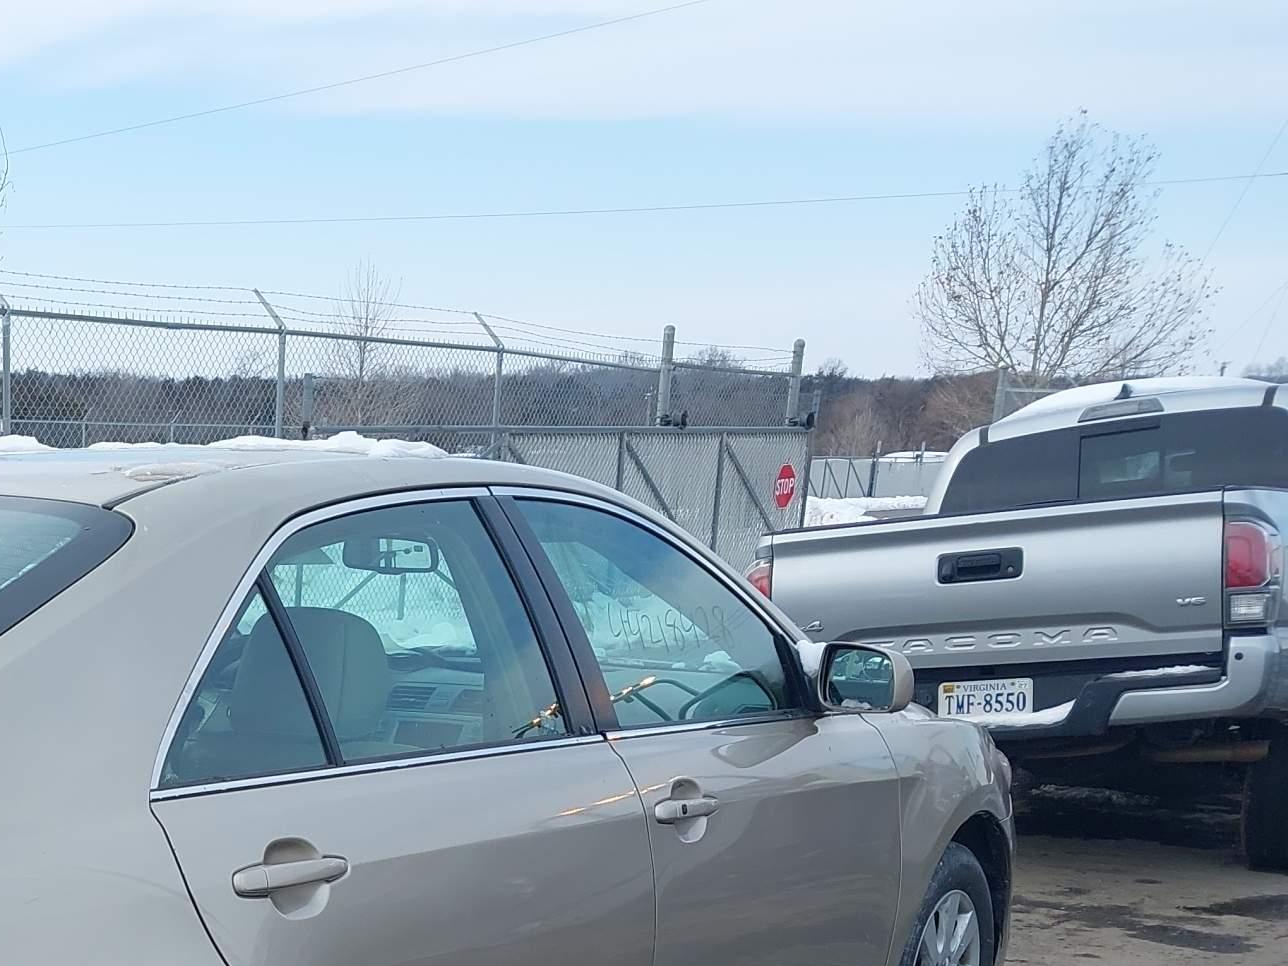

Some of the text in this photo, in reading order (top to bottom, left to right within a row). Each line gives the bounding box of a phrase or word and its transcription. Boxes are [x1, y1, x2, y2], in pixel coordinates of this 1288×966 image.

[775, 477, 795, 496] STOP
[607, 601, 734, 654] 44218428
[963, 682, 1007, 693] VIRGINIA
[944, 691, 1027, 715] TMF-8550
